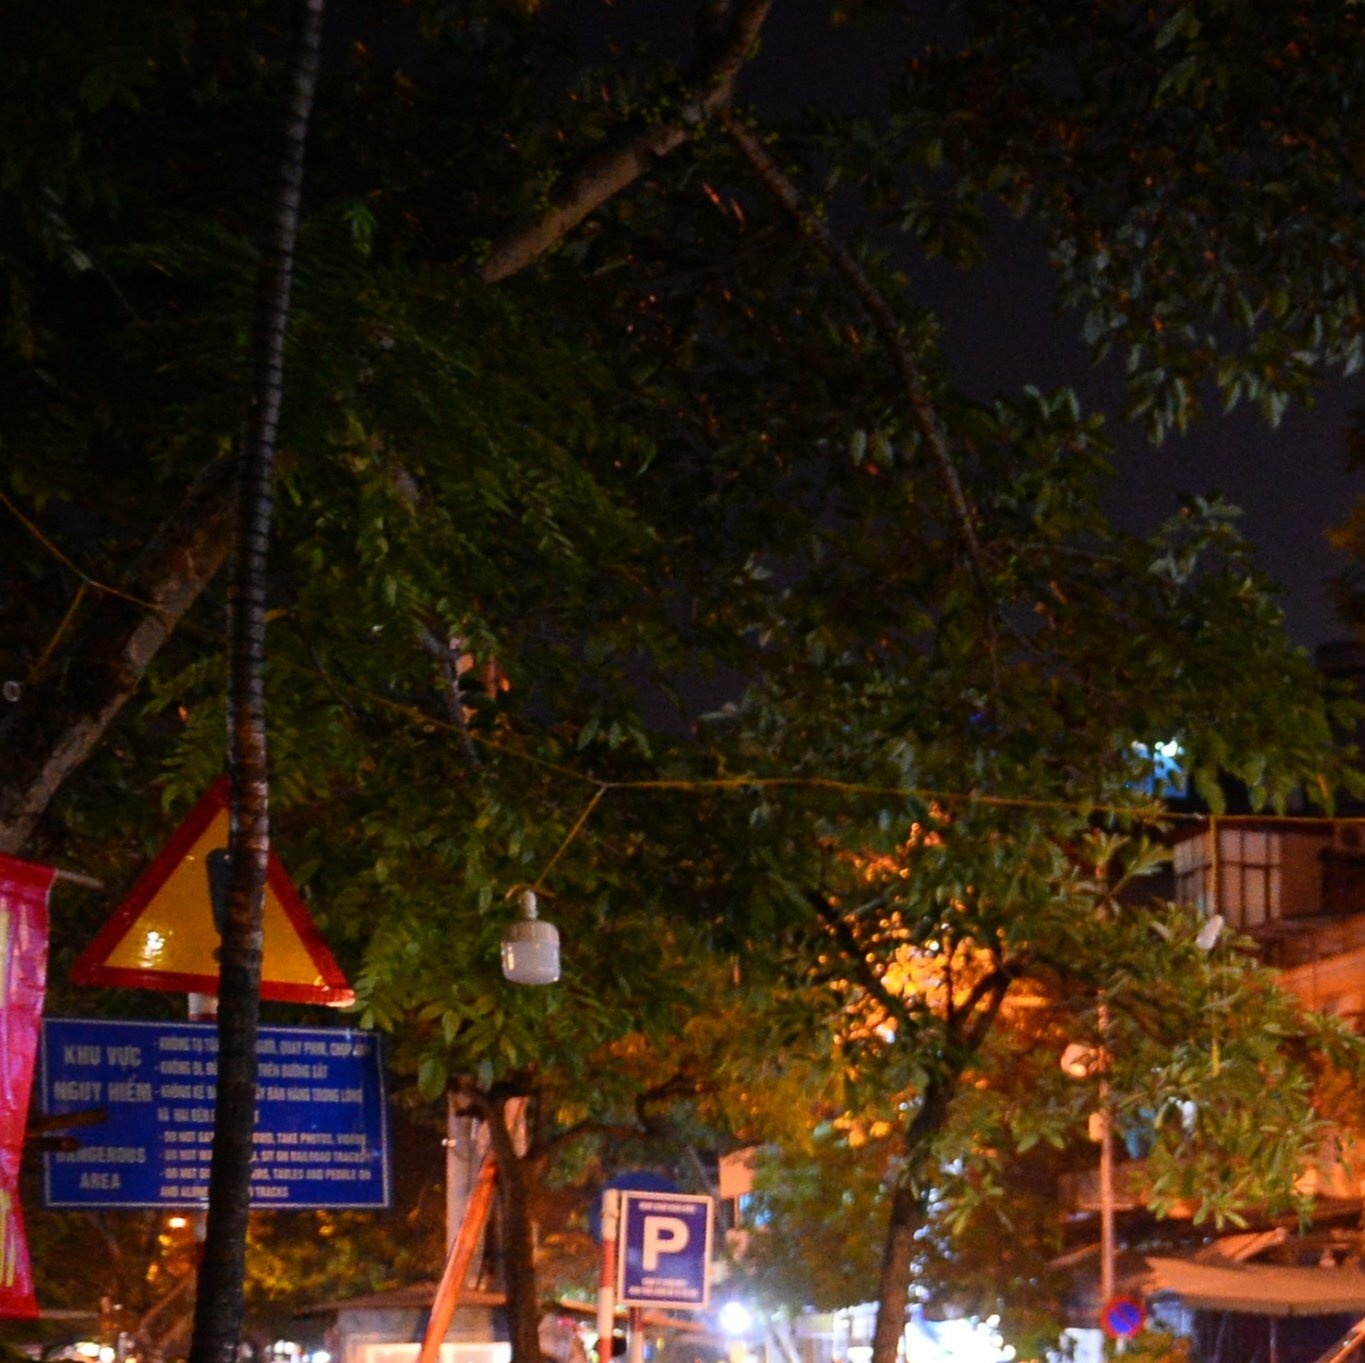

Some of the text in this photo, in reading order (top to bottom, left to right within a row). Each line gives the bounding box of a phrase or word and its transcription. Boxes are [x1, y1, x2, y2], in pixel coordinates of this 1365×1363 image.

[64, 1045, 101, 1066] KHU
[54, 1080, 102, 1102] NGUY
[80, 1171, 121, 1190] AREA
[642, 1215, 690, 1272] P
